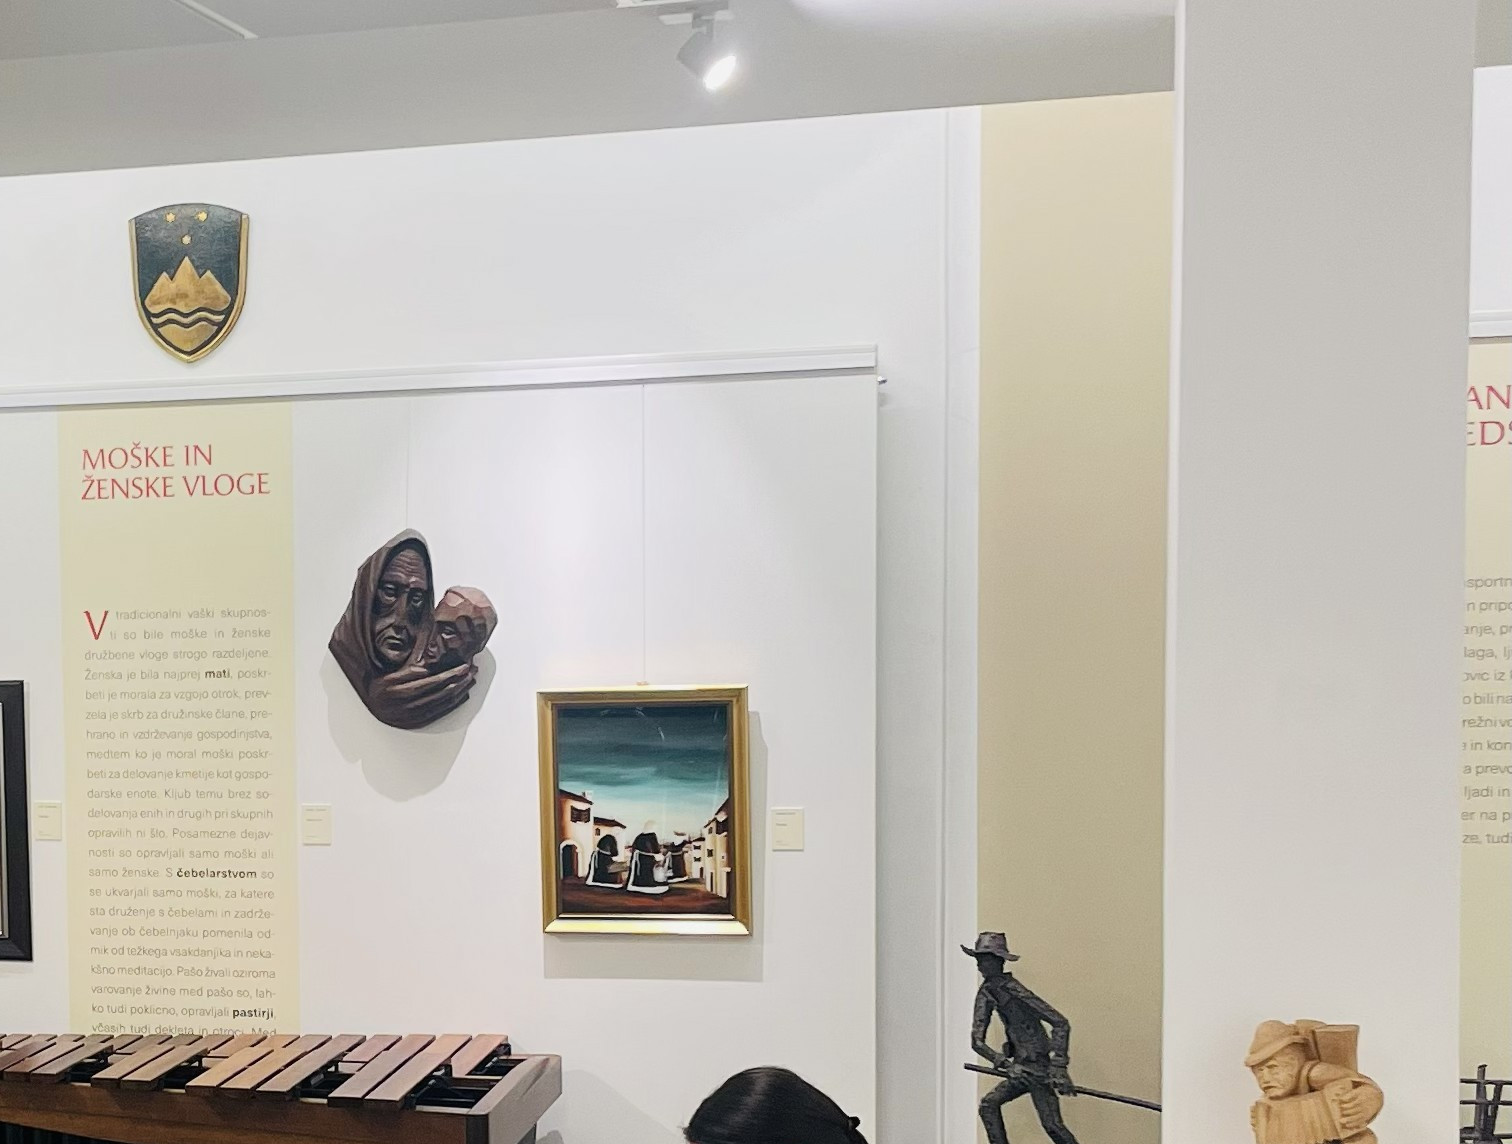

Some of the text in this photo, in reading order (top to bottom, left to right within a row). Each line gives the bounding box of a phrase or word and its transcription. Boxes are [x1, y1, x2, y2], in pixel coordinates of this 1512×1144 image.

[82, 441, 213, 470] MOŠKE IN
[81, 473, 271, 500] ŽENSKE VLOGE
[83, 610, 109, 641] V
[116, 608, 182, 620] tradicionalni
[187, 608, 215, 619] vaški
[109, 628, 271, 640] ti so bile moške in ženske
[84, 649, 135, 661] družbene
[139, 649, 168, 662] vloge
[172, 648, 208, 662] strogo
[84, 667, 123, 680] Ženska
[126, 669, 136, 682] je
[140, 669, 159, 680] bila
[163, 669, 201, 682] najprej
[85, 689, 105, 700] beti
[108, 689, 117, 702] je
[119, 689, 156, 700] morala
[158, 691, 172, 700] za
[174, 688, 209, 702] vzgojo
[85, 709, 106, 720] zela
[109, 709, 118, 722] je
[121, 709, 144, 720] skrb
[146, 711, 158, 720] za
[160, 708, 213, 720] družinske
[86, 729, 116, 740] hrano
[120, 729, 129, 740] in
[133, 728, 193, 742] vzdrževanje
[86, 748, 130, 759] medtem
[135, 748, 148, 759] ko
[152, 748, 162, 762] je
[166, 748, 196, 759] moral
[201, 748, 234, 759] moški
[87, 768, 106, 779] beti
[108, 771, 120, 779] za
[122, 768, 173, 782] delovanje
[175, 768, 214, 782] kmetije
[216, 768, 233, 779] kot
[87, 788, 122, 799] darske
[164, 787, 191, 801] Kljub
[196, 788, 223, 799] temu
[228, 788, 252, 799] brez
[88, 808, 274, 821] delovanja enih in drugih pri skupnih
[88, 828, 132, 841] opravilih
[136, 828, 146, 839] ni
[172, 827, 236, 839] Posamezne
[88, 847, 274, 861] nosti so opravljali samo moški ali
[88, 870, 118, 878] samo
[165, 867, 173, 878] S
[176, 867, 257, 879] čebelarstvom
[260, 871, 274, 879] so
[89, 889, 102, 897] se
[105, 886, 149, 900] ukvarjali
[152, 890, 183, 898] samo
[224, 890, 237, 899] za
[240, 888, 274, 899] katere
[89, 906, 106, 917] sta
[108, 906, 156, 920] druženje
[158, 909, 165, 918] s
[168, 907, 218, 918] čebelami
[220, 907, 231, 918] in
[90, 925, 118, 939] vanje
[122, 925, 136, 937] ob
[139, 926, 198, 940] čebelnjaku
[202, 927, 253, 940] pomenila
[90, 945, 109, 956] mik
[111, 945, 125, 956] od
[126, 945, 168, 959] težkega
[169, 946, 232, 960] vsakdanjika
[233, 947, 244, 958] in
[90, 964, 116, 976] kšno
[176, 965, 203, 977] Pašo
[204, 967, 230, 978] živali
[232, 967, 276, 979] oziroma
[91, 984, 142, 998] varovanje
[145, 985, 176, 996] živine
[179, 986, 203, 997] med
[206, 986, 234, 1000] pašo
[92, 1003, 104, 1014] ko
[106, 1004, 127, 1015] tudi
[180, 1005, 230, 1020] opravljali
[92, 1022, 126, 1034] včasih
[130, 1023, 150, 1034] tudi
